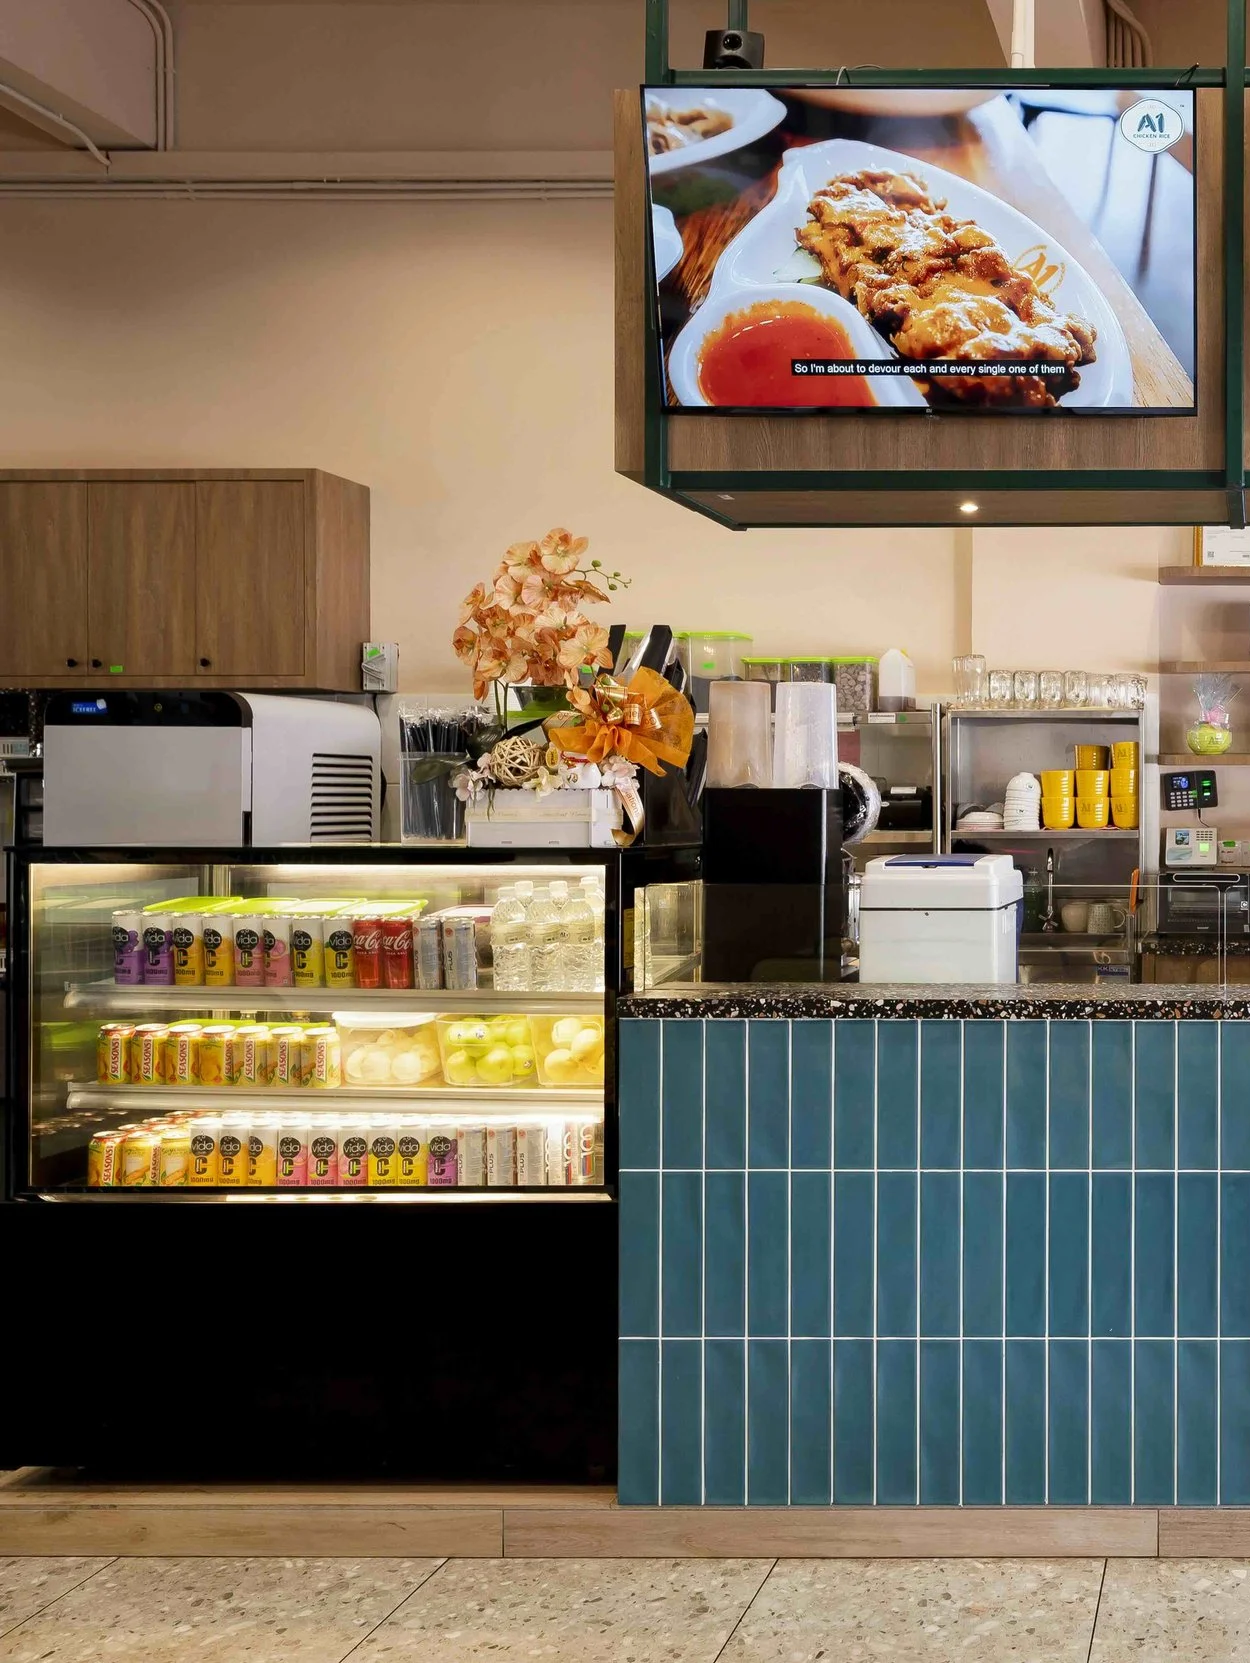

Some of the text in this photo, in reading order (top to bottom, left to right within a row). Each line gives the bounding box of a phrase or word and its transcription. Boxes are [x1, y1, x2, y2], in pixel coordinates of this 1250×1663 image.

[1138, 113, 1164, 133] A1
[795, 364, 807, 373] So
[811, 364, 824, 373] I'm
[828, 364, 854, 373] about
[857, 365, 866, 373] to
[869, 364, 901, 373] devour
[904, 364, 927, 373] each
[930, 364, 947, 373] and
[950, 366, 975, 375] every
[979, 364, 1006, 375] single
[1028, 364, 1038, 373] of
[1041, 364, 1064, 373] them
[237, 935, 257, 943] vida
[335, 952, 348, 969] C
[111, 1041, 119, 1073] SEASONS
[143, 1040, 151, 1074] SEASONS
[191, 1141, 214, 1150] vida
[312, 1143, 334, 1152] vida
[344, 1143, 366, 1152] vida
[372, 1143, 394, 1152] vida
[401, 1143, 418, 1152] vida
[430, 1142, 450, 1151] vida
[103, 1149, 113, 1182] SEASONS
[316, 1158, 328, 1176] C
[377, 1158, 389, 1176] C
